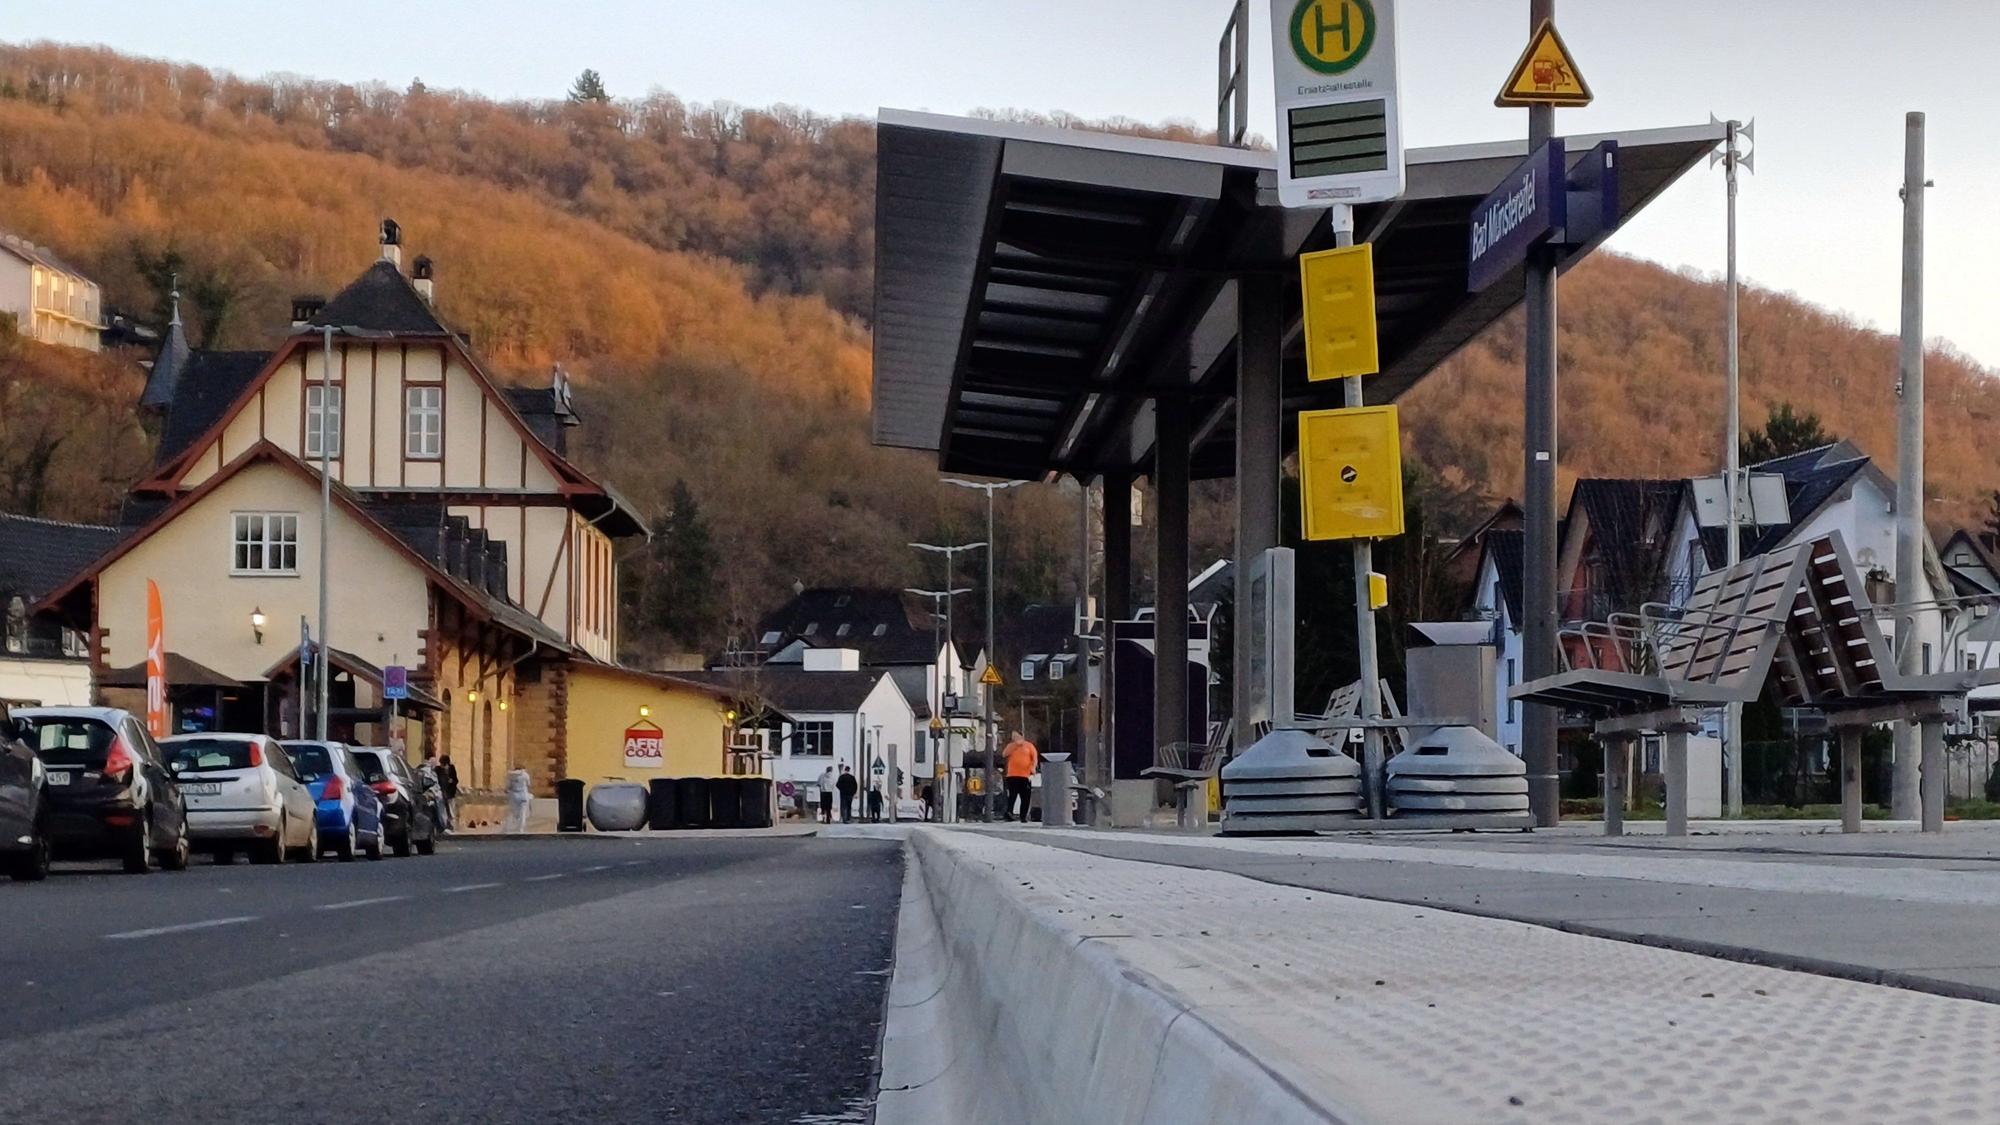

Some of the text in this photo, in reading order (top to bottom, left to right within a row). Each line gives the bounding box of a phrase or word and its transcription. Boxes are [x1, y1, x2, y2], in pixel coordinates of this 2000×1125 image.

[1314, 2, 1350, 55] H
[1472, 168, 1536, 262] Bad Münstereifel
[626, 748, 663, 758] COLA
